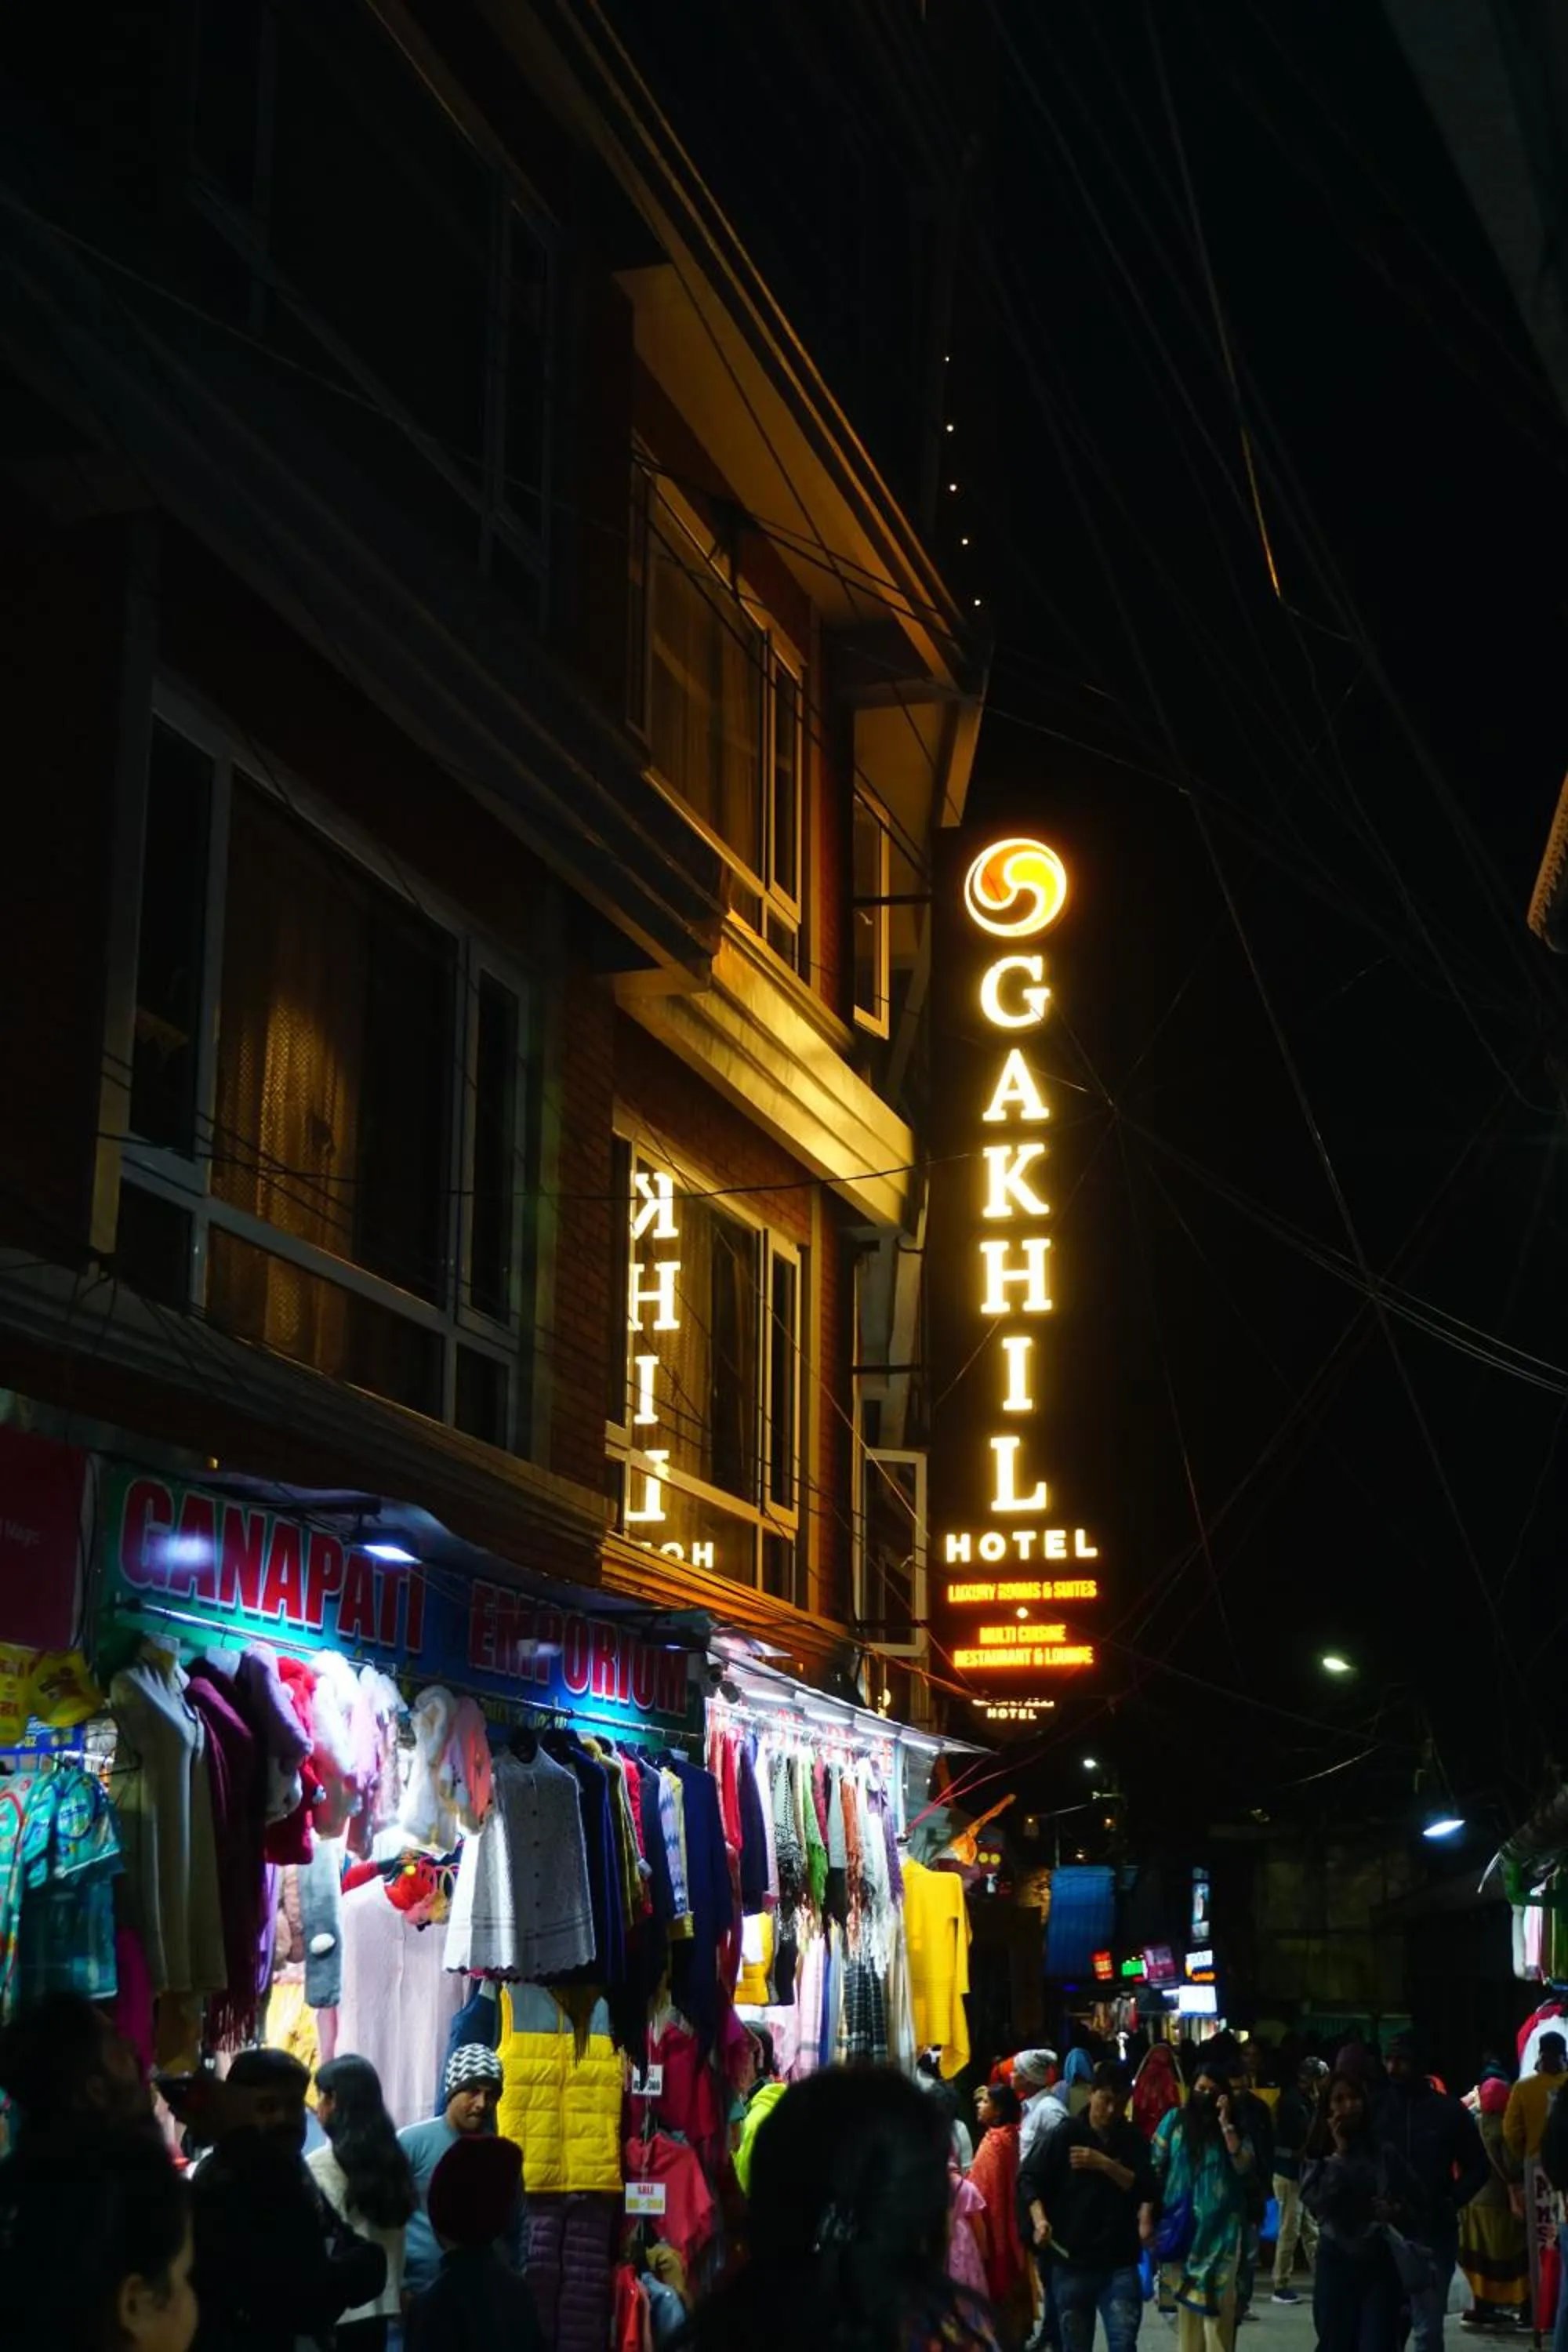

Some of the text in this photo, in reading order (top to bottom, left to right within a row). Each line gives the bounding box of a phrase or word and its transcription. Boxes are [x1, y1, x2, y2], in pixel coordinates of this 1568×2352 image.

[946, 1529, 1098, 1563] HOTEL
[948, 1582, 995, 1602] LUXURY
[997, 1581, 1041, 1600] ROOMS
[1053, 1580, 1097, 1599] SUITES
[979, 1624, 1066, 1644] MULTI CUISINE
[470, 1577, 688, 1717] EMPORIUM
[953, 1649, 1032, 1668] RESTAURANT
[986, 1708, 1037, 1719] HOTEL
